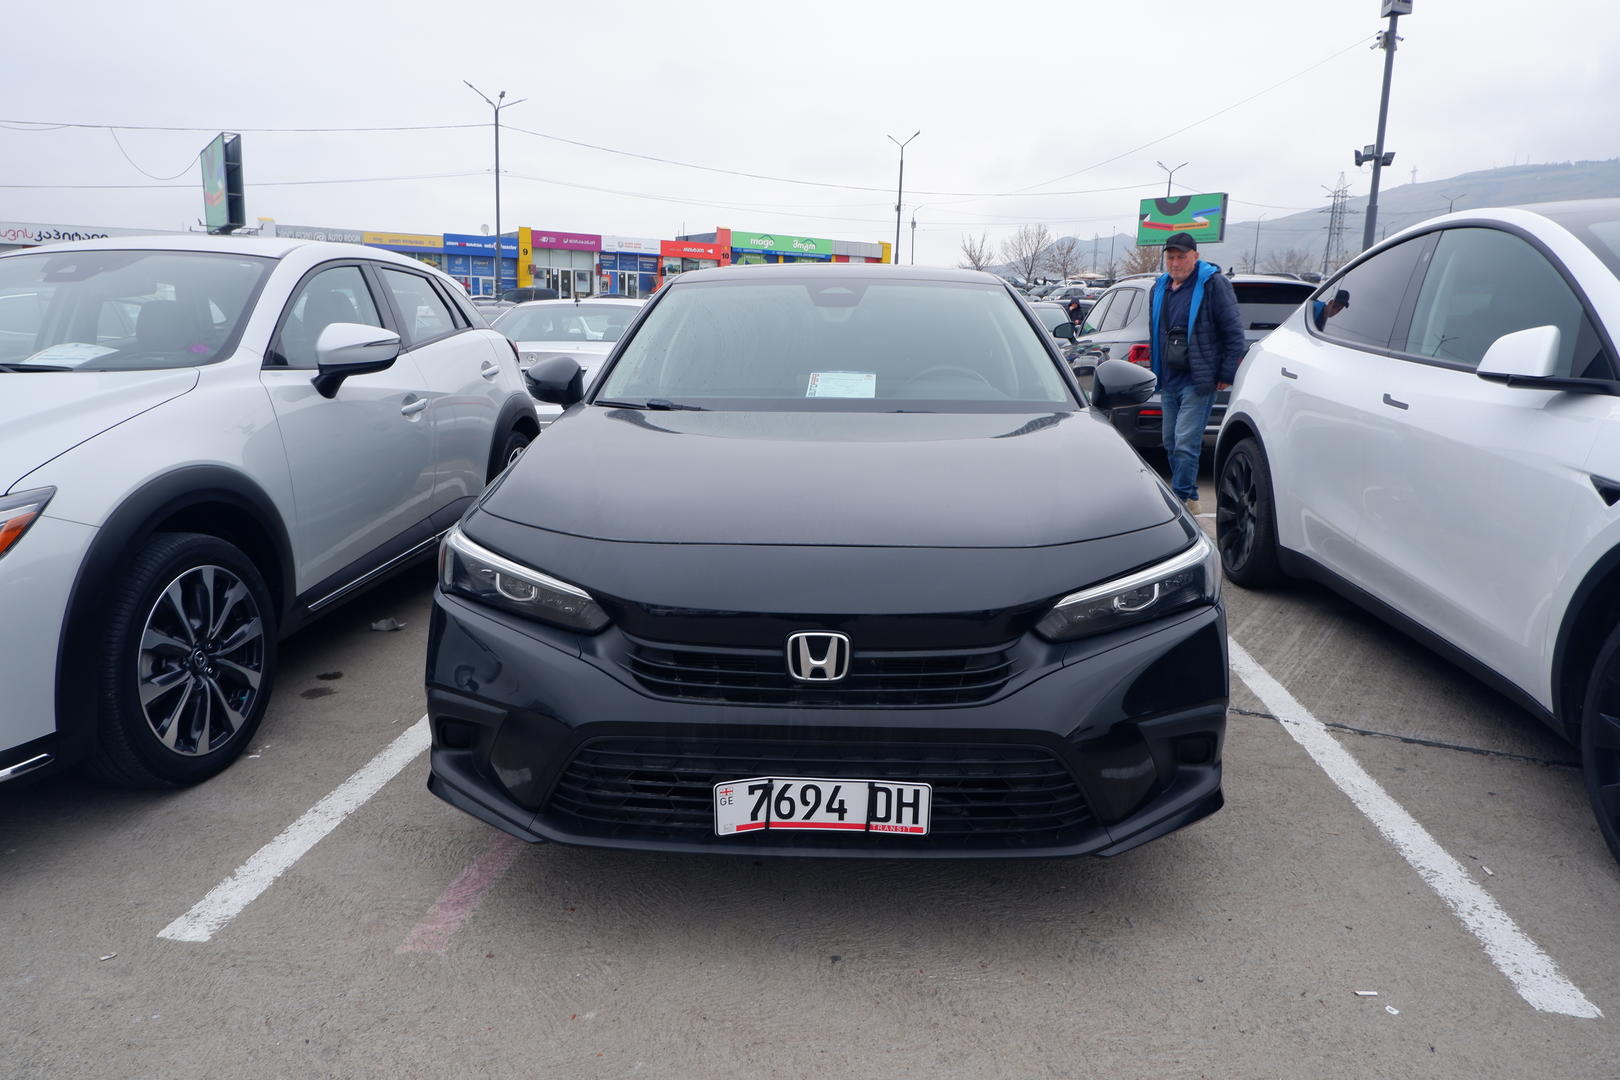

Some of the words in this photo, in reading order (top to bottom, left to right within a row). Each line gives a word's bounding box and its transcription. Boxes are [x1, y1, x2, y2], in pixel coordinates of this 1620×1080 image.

[750, 238, 774, 249] mogo
[522, 248, 528, 256] 9
[722, 252, 730, 260] 10
[719, 796, 734, 806] GE
[747, 783, 848, 822] 7694
[868, 785, 921, 825] DH
[871, 825, 912, 833] TRANSIT
